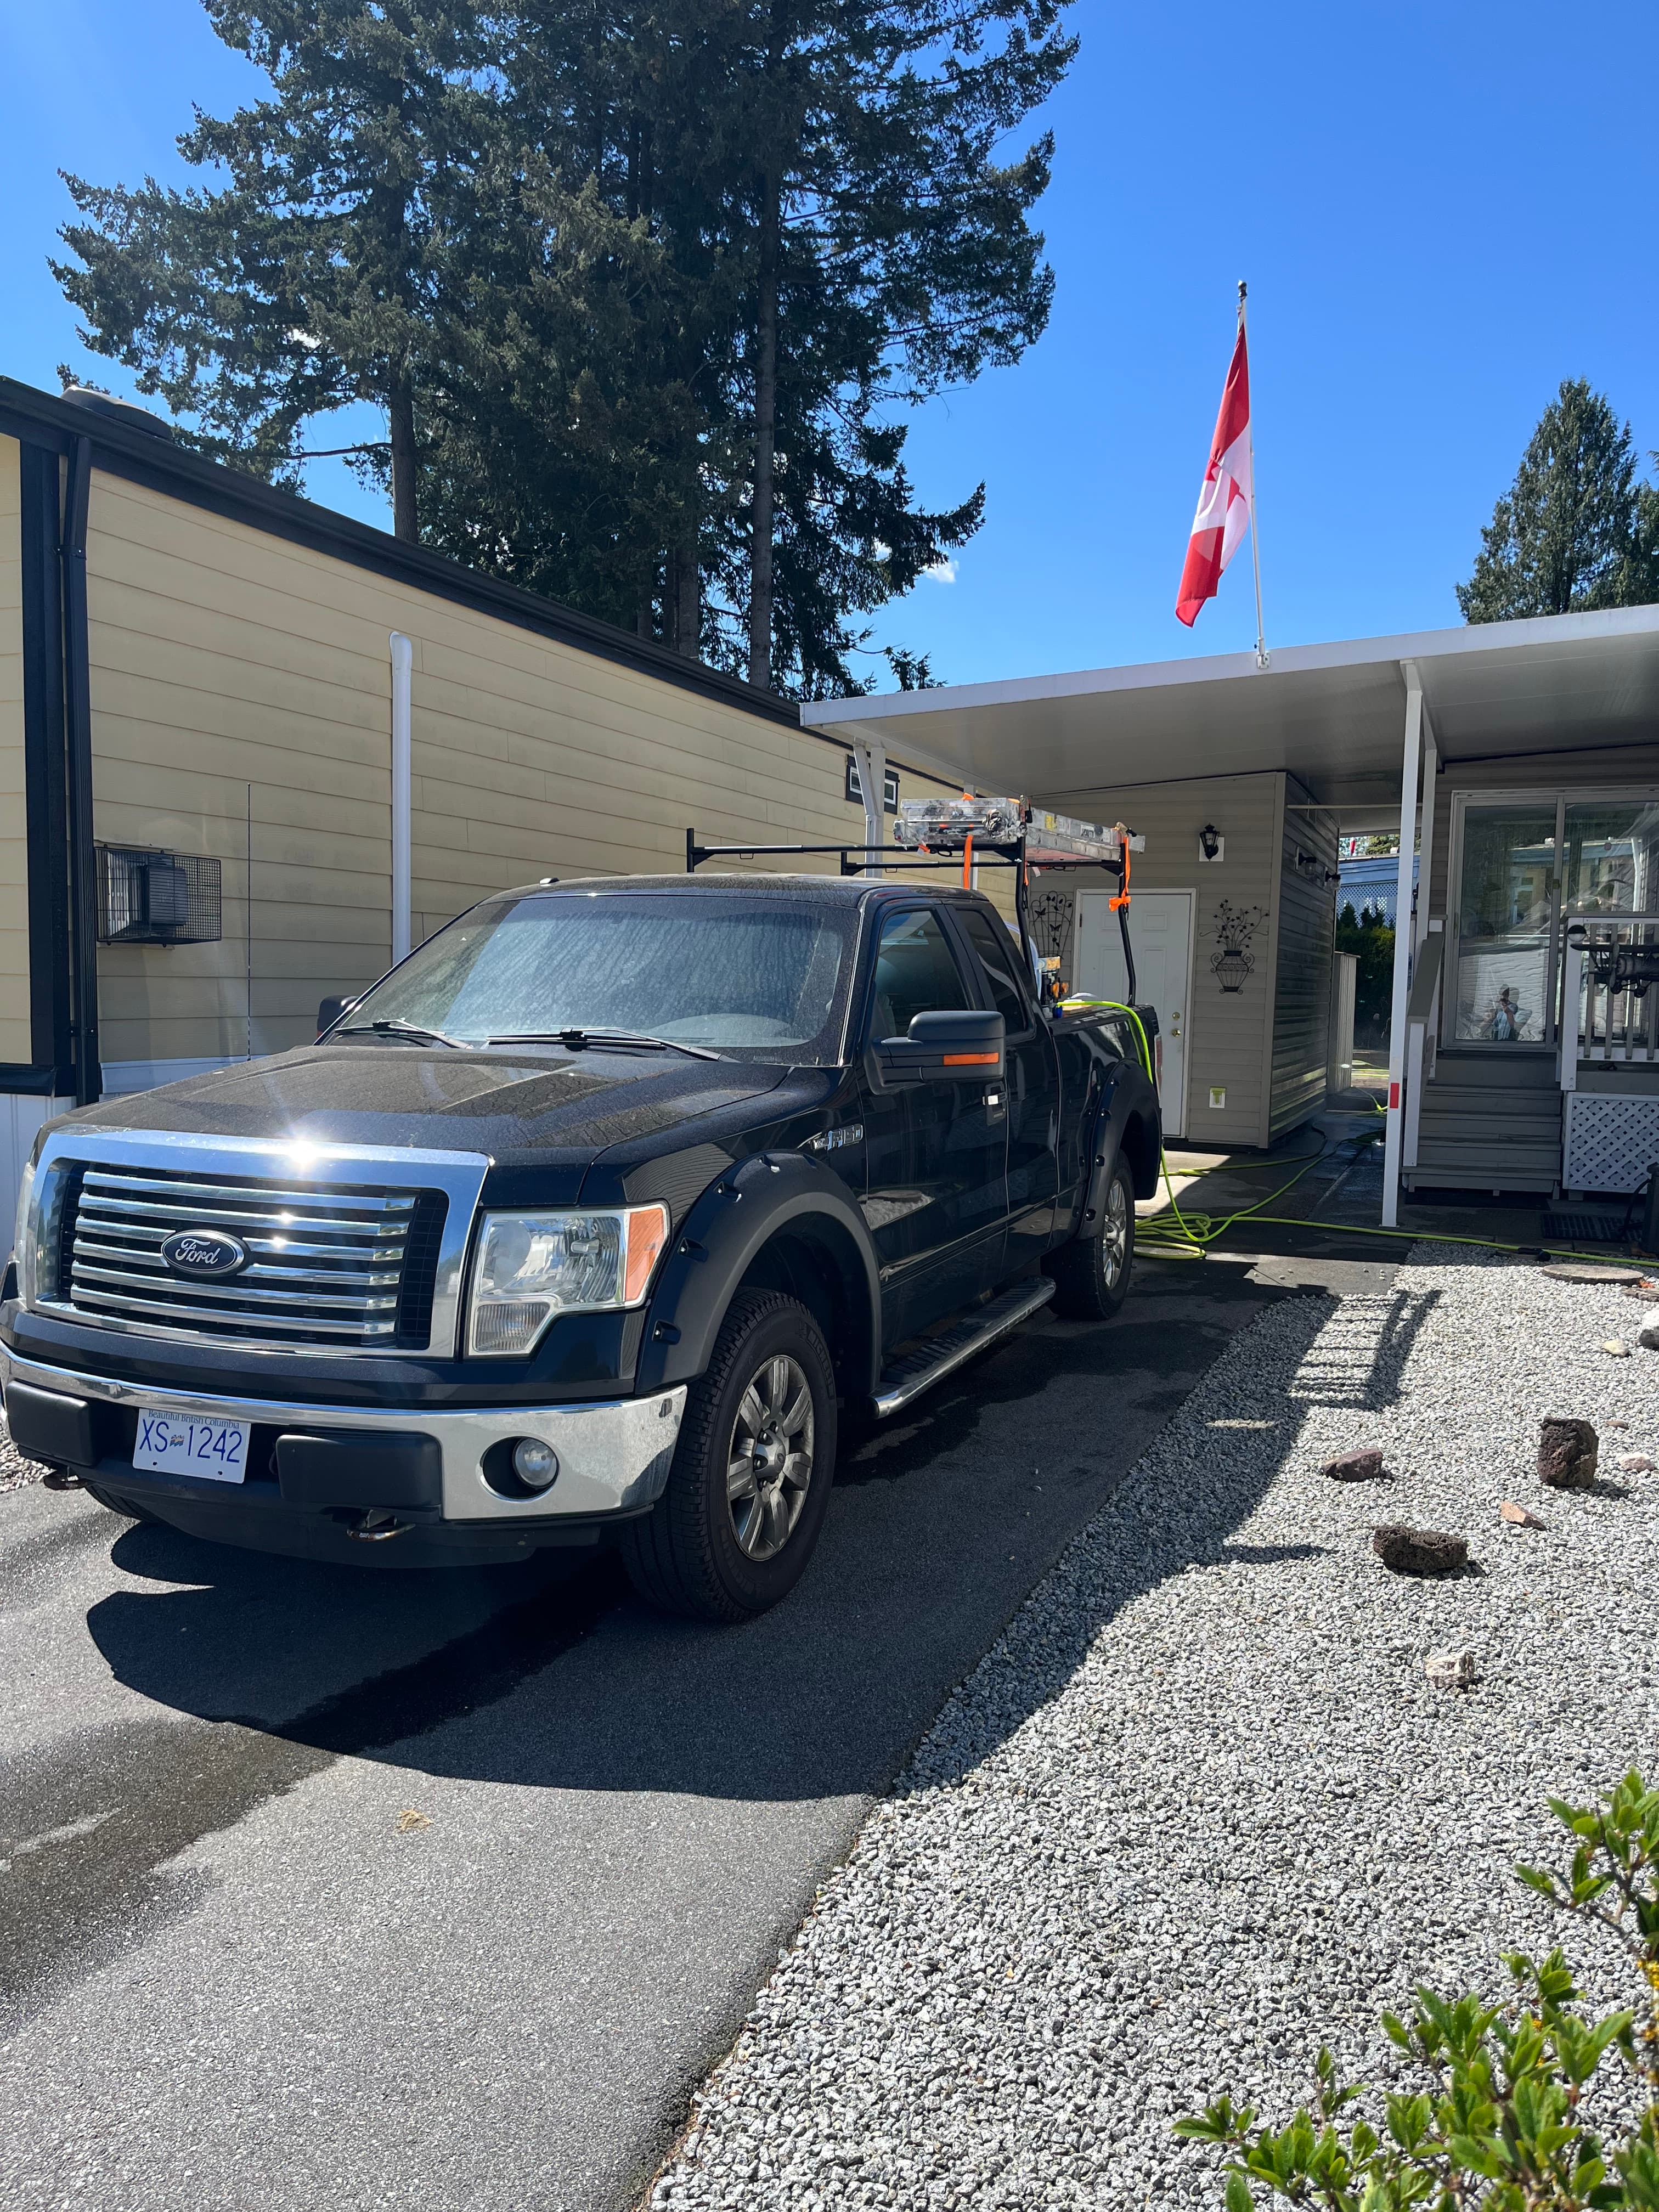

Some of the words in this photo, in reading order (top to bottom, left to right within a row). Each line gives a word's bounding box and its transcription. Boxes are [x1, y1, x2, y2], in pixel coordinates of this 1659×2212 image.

[175, 1238, 221, 1265] Ford
[148, 1409, 180, 1421] Beautiful
[181, 1414, 204, 1425] British
[205, 1418, 240, 1430] Columbia
[139, 1419, 170, 1453] XS
[188, 1424, 242, 1463] 1242
